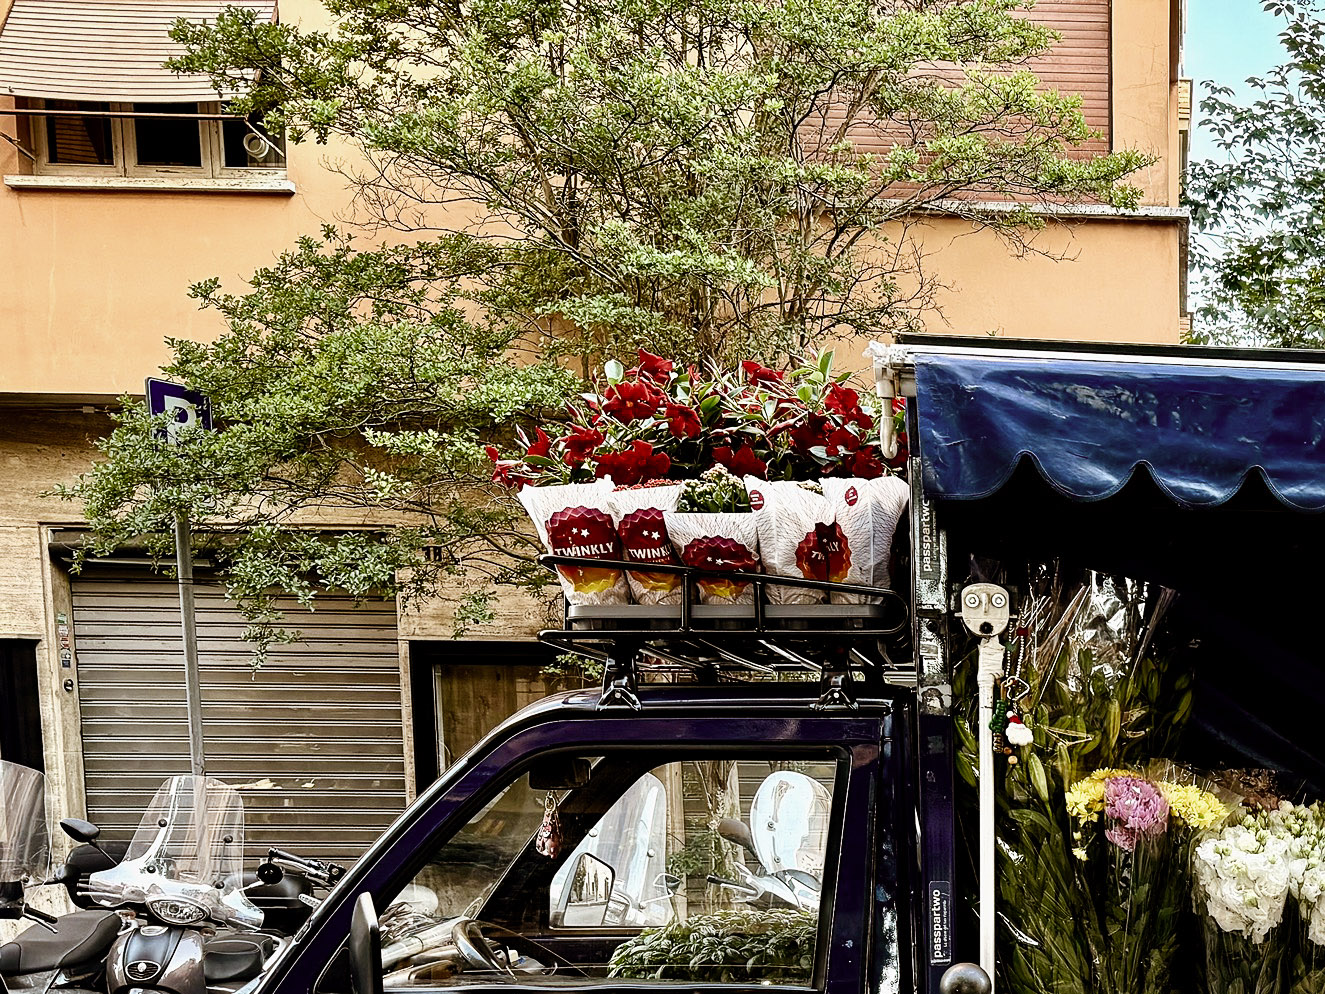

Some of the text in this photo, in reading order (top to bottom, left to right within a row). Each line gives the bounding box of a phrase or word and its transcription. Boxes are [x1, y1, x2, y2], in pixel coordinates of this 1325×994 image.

[164, 395, 197, 444] P
[554, 541, 614, 558] TWINKLY
[931, 889, 944, 958] passpartwo
